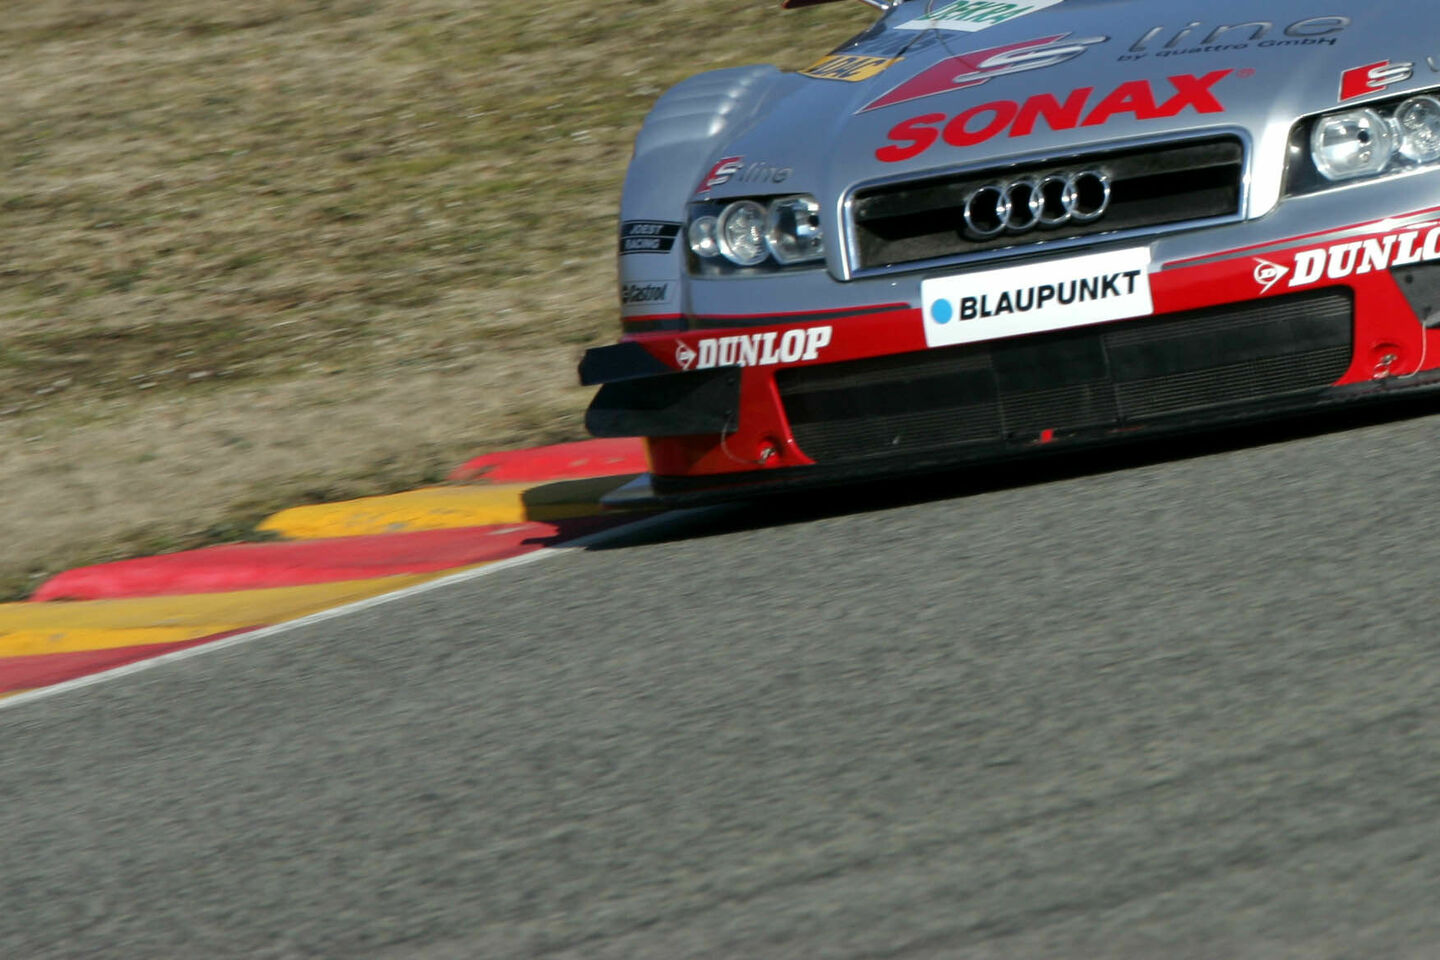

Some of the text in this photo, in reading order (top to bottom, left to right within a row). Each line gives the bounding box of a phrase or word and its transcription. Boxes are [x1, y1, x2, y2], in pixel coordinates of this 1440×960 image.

[914, 0, 1036, 25] DEKRA
[1116, 36, 1339, 62] by quattro GmbH
[1127, 15, 1351, 53] line
[874, 68, 1235, 163] SONAX
[958, 269, 1142, 321] BLAUPUNKT
[695, 325, 833, 370] DUNLOP
